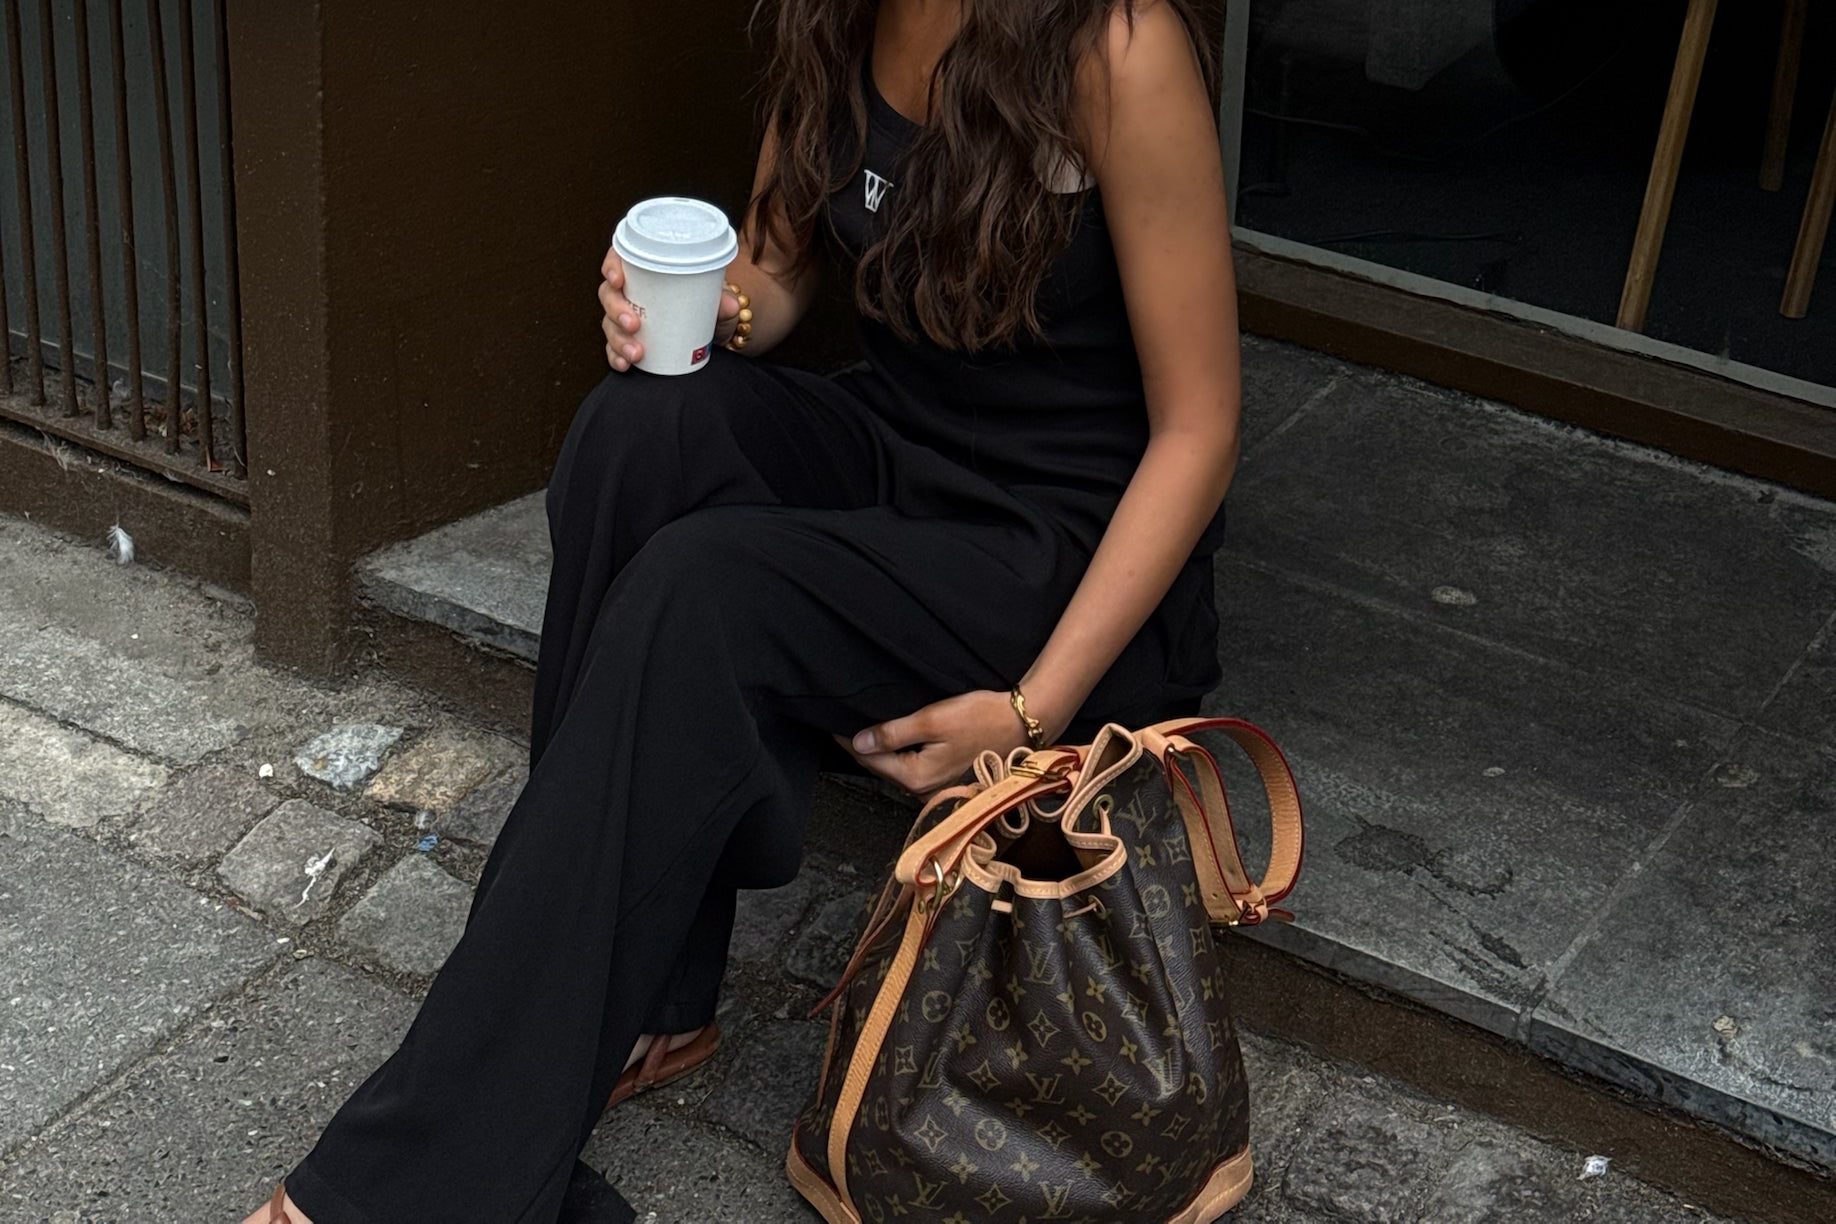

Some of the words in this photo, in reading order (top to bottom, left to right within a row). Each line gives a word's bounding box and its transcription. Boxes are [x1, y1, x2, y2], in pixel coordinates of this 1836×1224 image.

[1022, 938, 1058, 985] LV
[1025, 1072, 1067, 1105] LV
[908, 1171, 949, 1210] LV
[1036, 1179, 1073, 1219] LV
